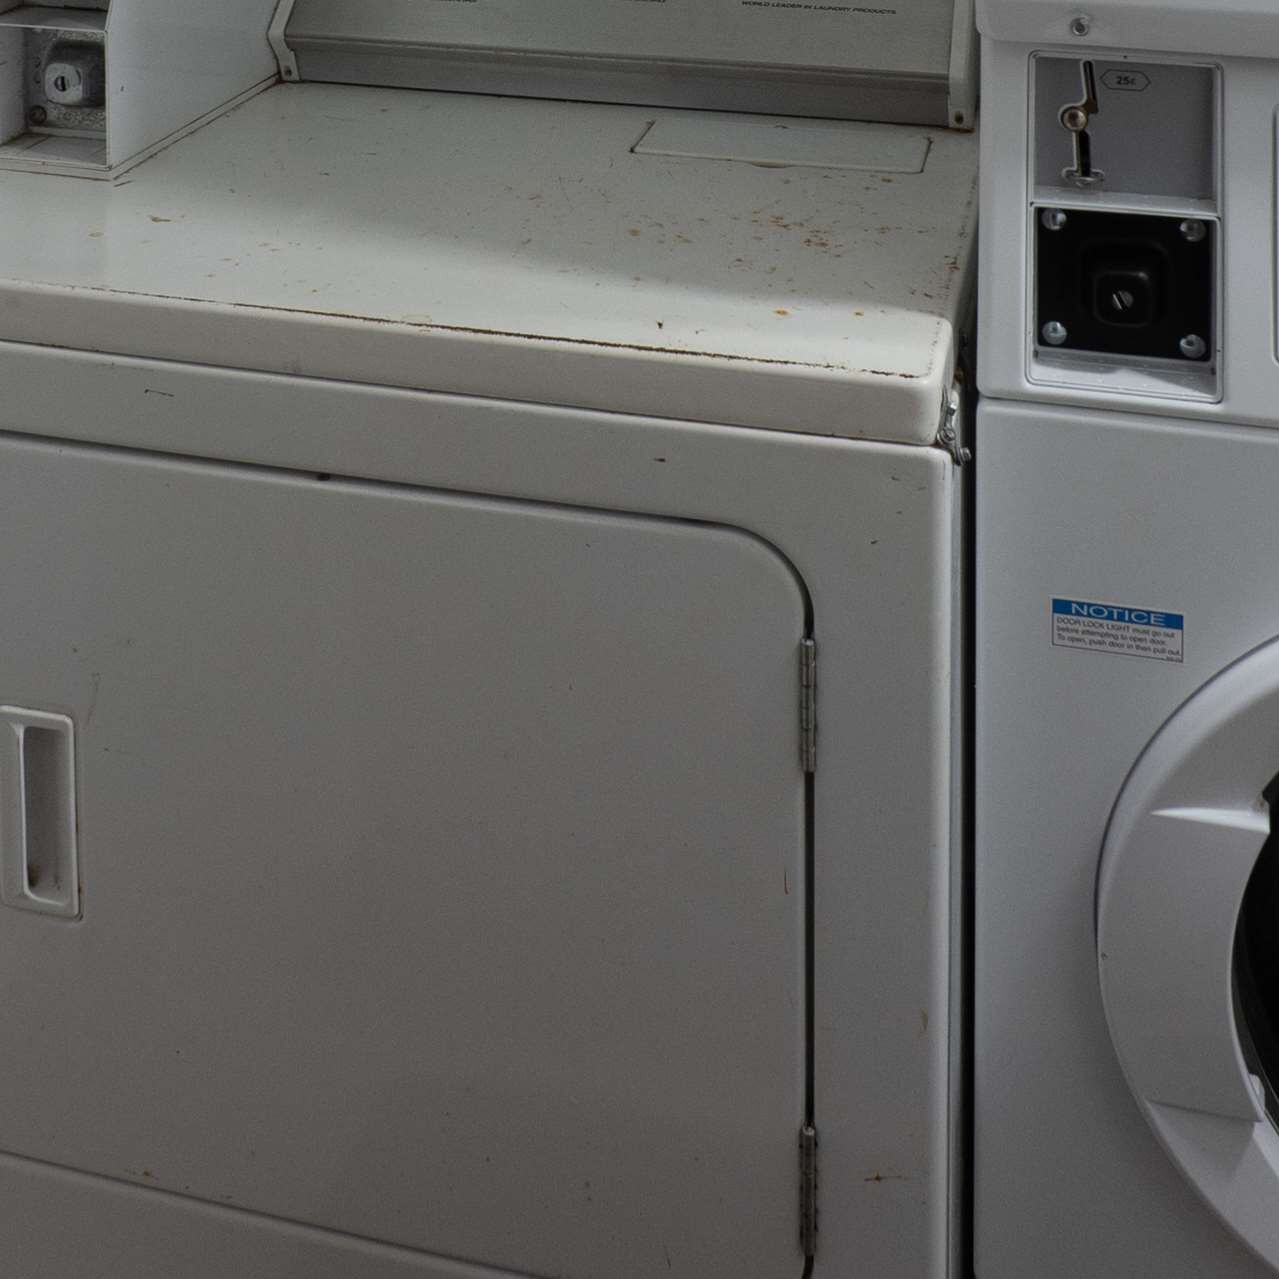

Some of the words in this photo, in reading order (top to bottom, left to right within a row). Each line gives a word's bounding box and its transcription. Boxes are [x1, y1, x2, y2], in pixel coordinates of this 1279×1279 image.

[1072, 603, 1166, 625] NOTICE
[1057, 617, 1080, 626] DOOR
[1083, 620, 1104, 629] LOCK
[1107, 623, 1130, 631] LIGHT
[1132, 627, 1150, 635] must
[1152, 630, 1162, 638] go
